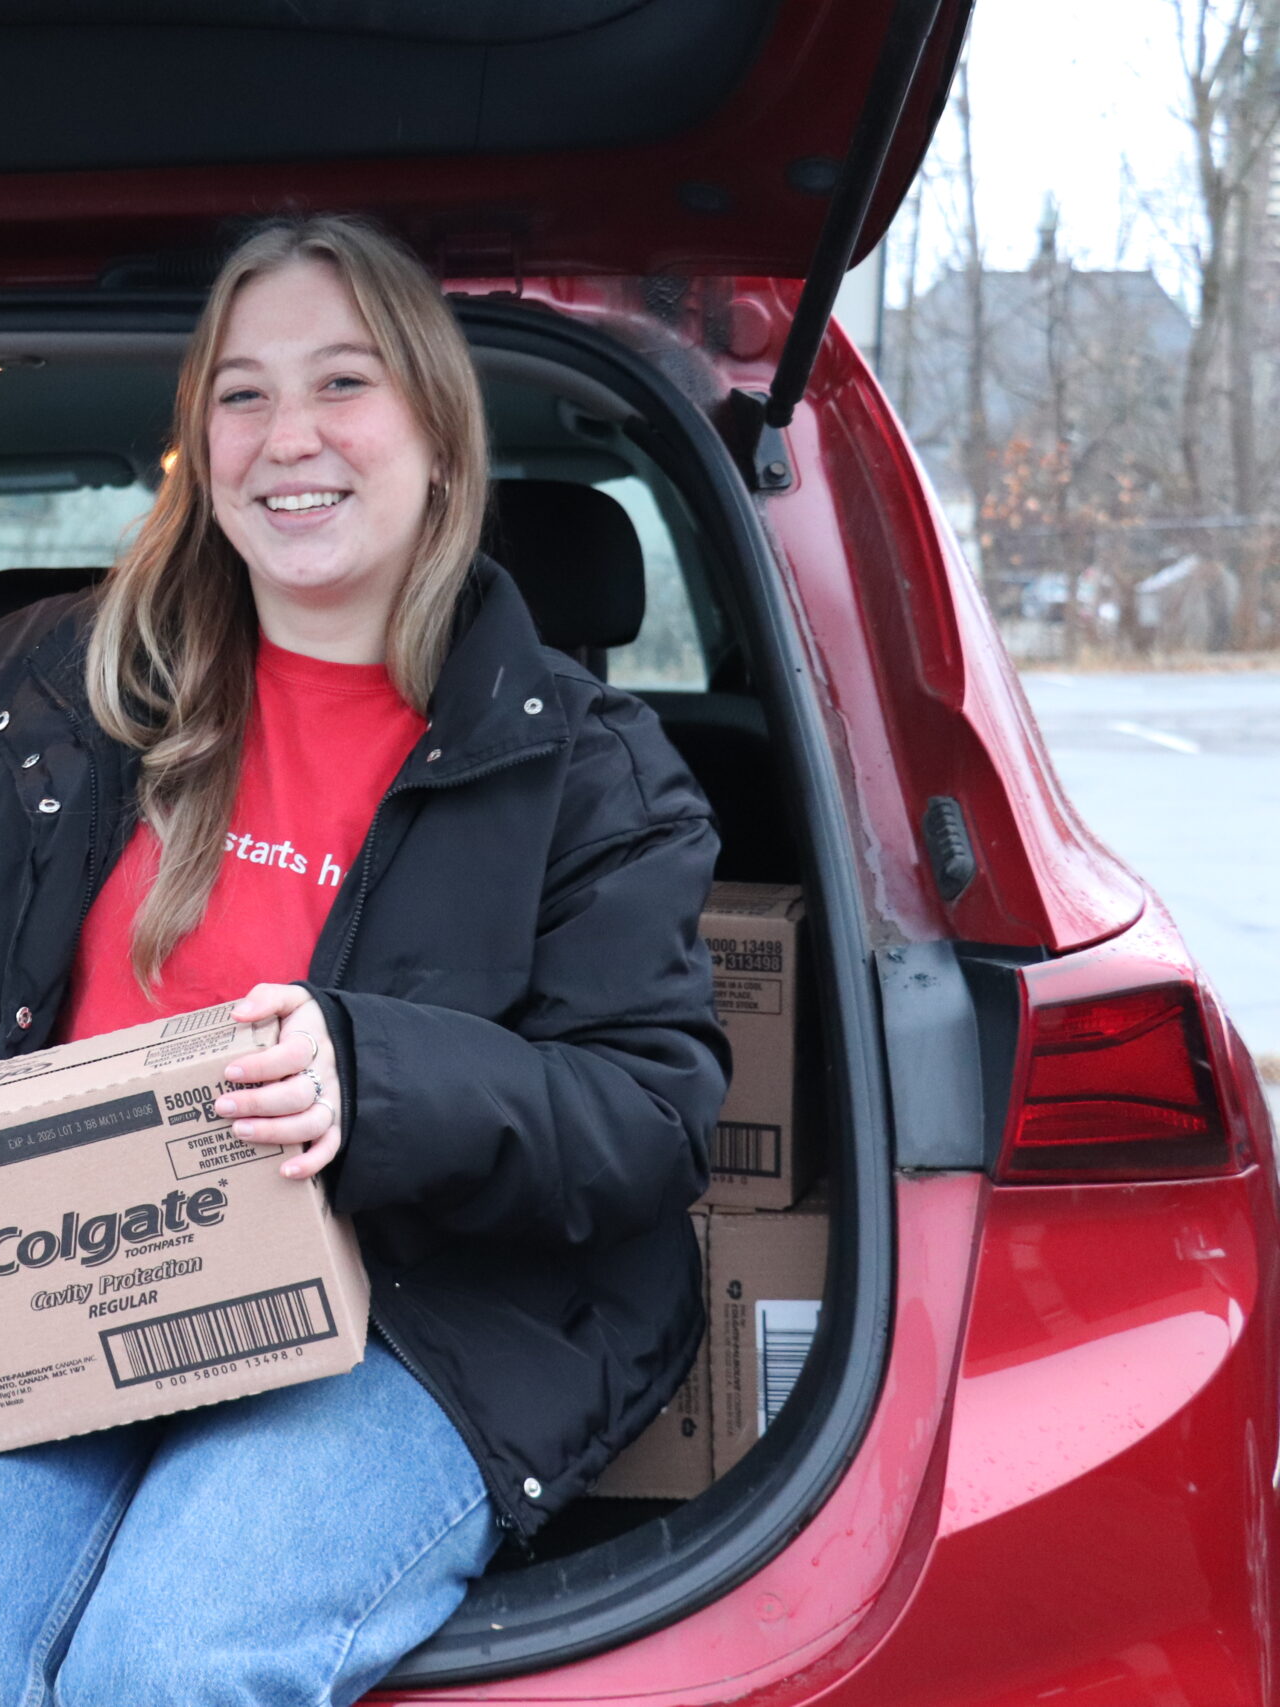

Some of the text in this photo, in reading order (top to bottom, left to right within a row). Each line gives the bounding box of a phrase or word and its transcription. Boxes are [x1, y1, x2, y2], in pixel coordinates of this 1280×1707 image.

[224, 832, 348, 887] starts h
[164, 1085, 212, 1111] 58000
[58, 1124, 73, 1137] LOT
[187, 1134, 214, 1149] STORE
[215, 1133, 225, 1142] IN
[199, 1147, 257, 1169] ROTATE STOCK
[201, 1147, 219, 1157] DRY
[124, 1234, 194, 1258] TOOTHPASTE
[30, 1256, 202, 1311] Cavity Protection
[88, 1290, 158, 1319] REGULAR
[54, 1358, 81, 1370] CANADA
[155, 1347, 303, 1390] 0 00 58000 13498 0
[18, 1373, 49, 1386] CANADA
